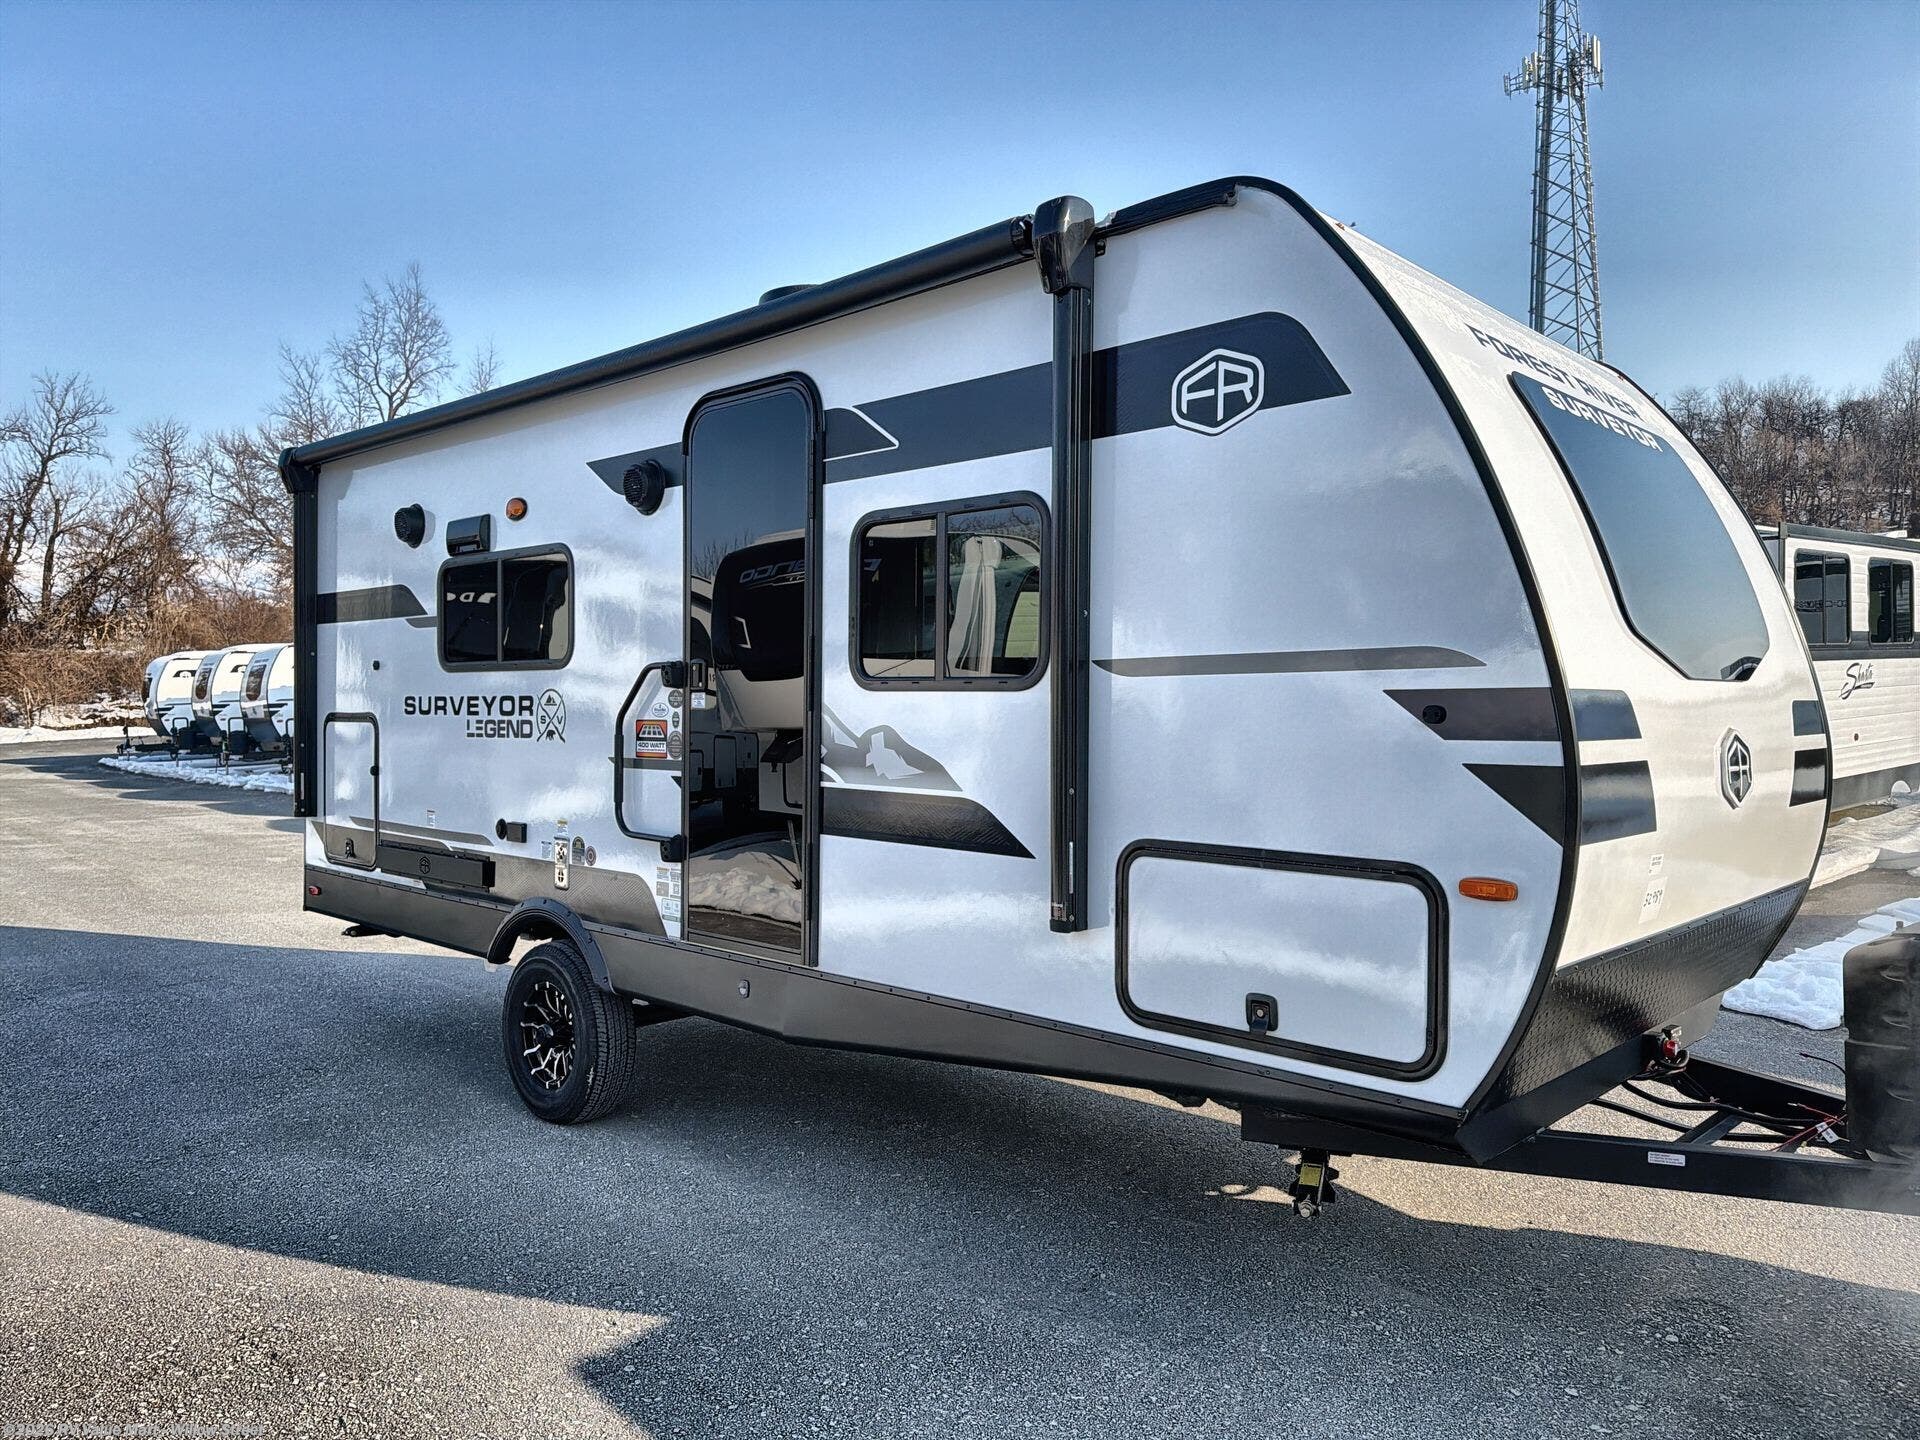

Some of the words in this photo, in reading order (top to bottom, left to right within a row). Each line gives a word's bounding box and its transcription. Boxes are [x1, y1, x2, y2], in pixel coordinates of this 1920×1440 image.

[1464, 322, 1576, 389] FOREST
[1571, 375, 1646, 423] RIVER
[1541, 386, 1664, 453] SURVEYOR
[404, 695, 534, 717] SURVEYOR
[466, 719, 534, 739] LEGEND
